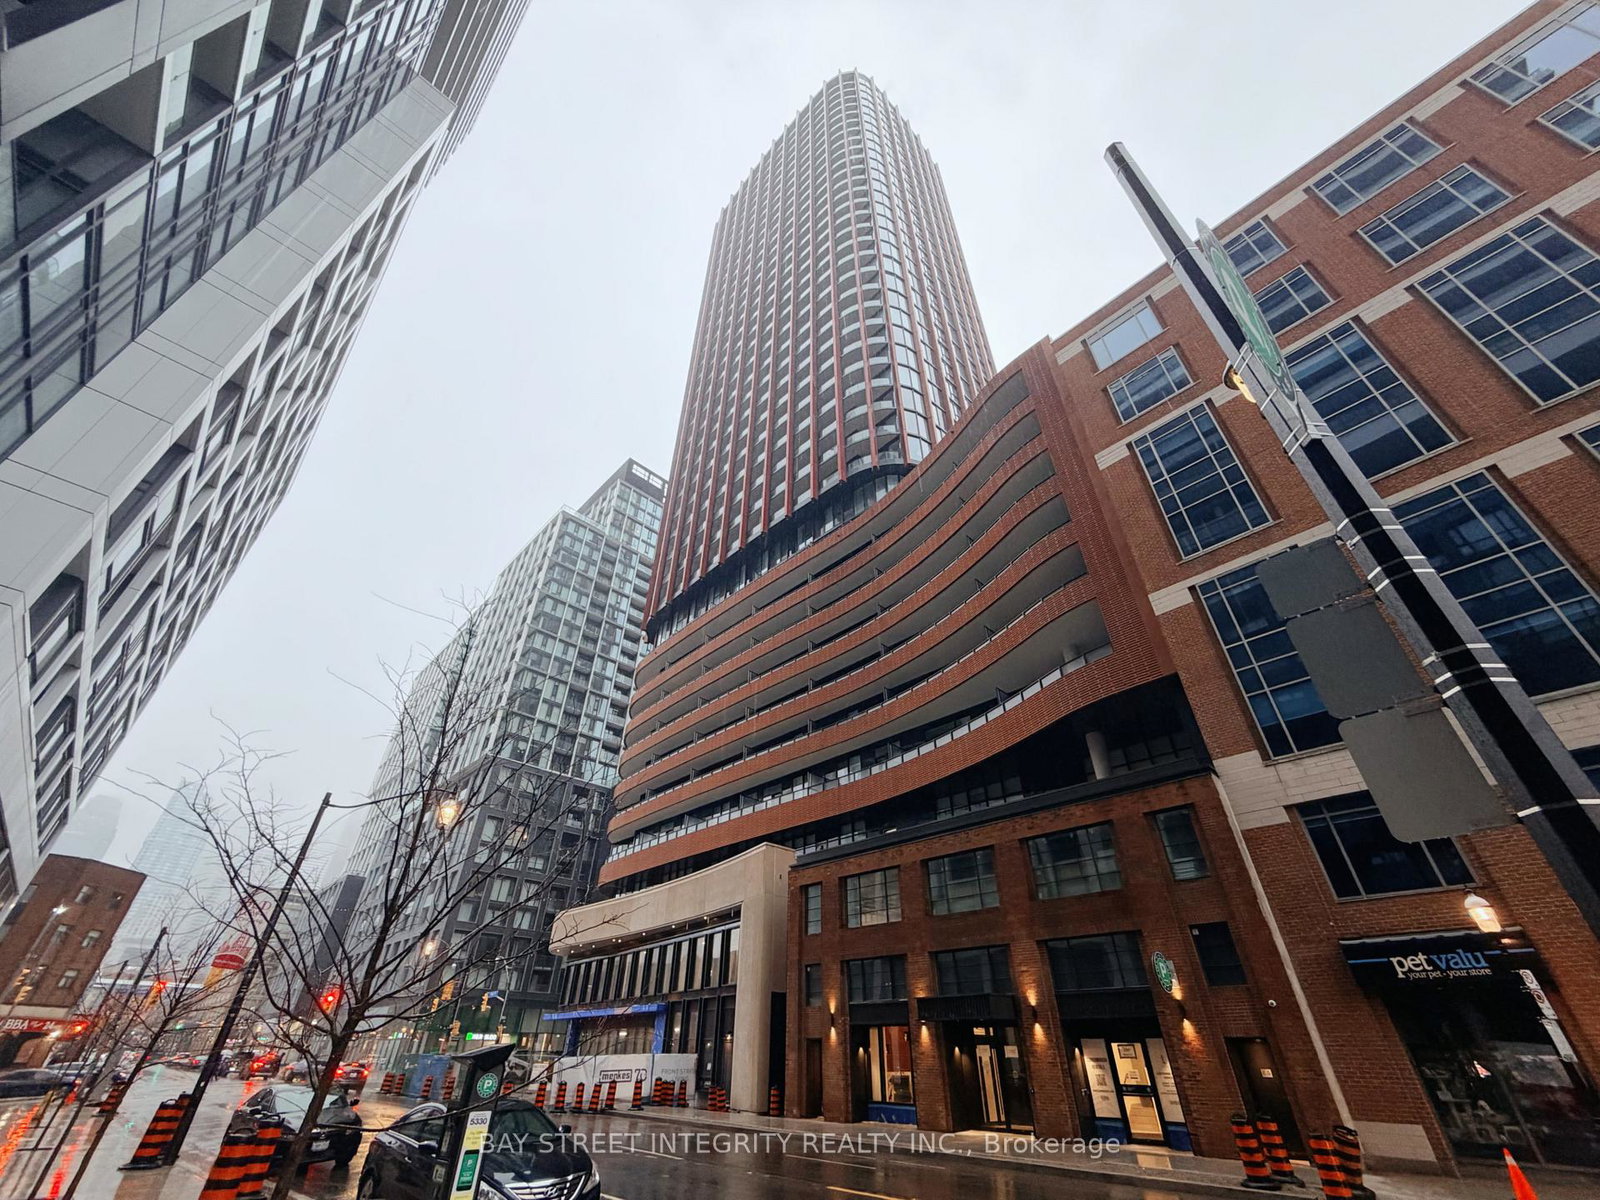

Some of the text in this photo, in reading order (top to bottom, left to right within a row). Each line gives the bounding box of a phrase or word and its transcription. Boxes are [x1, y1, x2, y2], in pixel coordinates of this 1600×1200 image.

[1389, 949, 1490, 978] pet valu
[1407, 971, 1427, 980] your
[1428, 970, 1441, 979] pet
[1447, 969, 1467, 979] your
[1469, 968, 1492, 976] store
[602, 1071, 630, 1081] menkes
[482, 1079, 493, 1091] P
[470, 1117, 488, 1126] 5330
